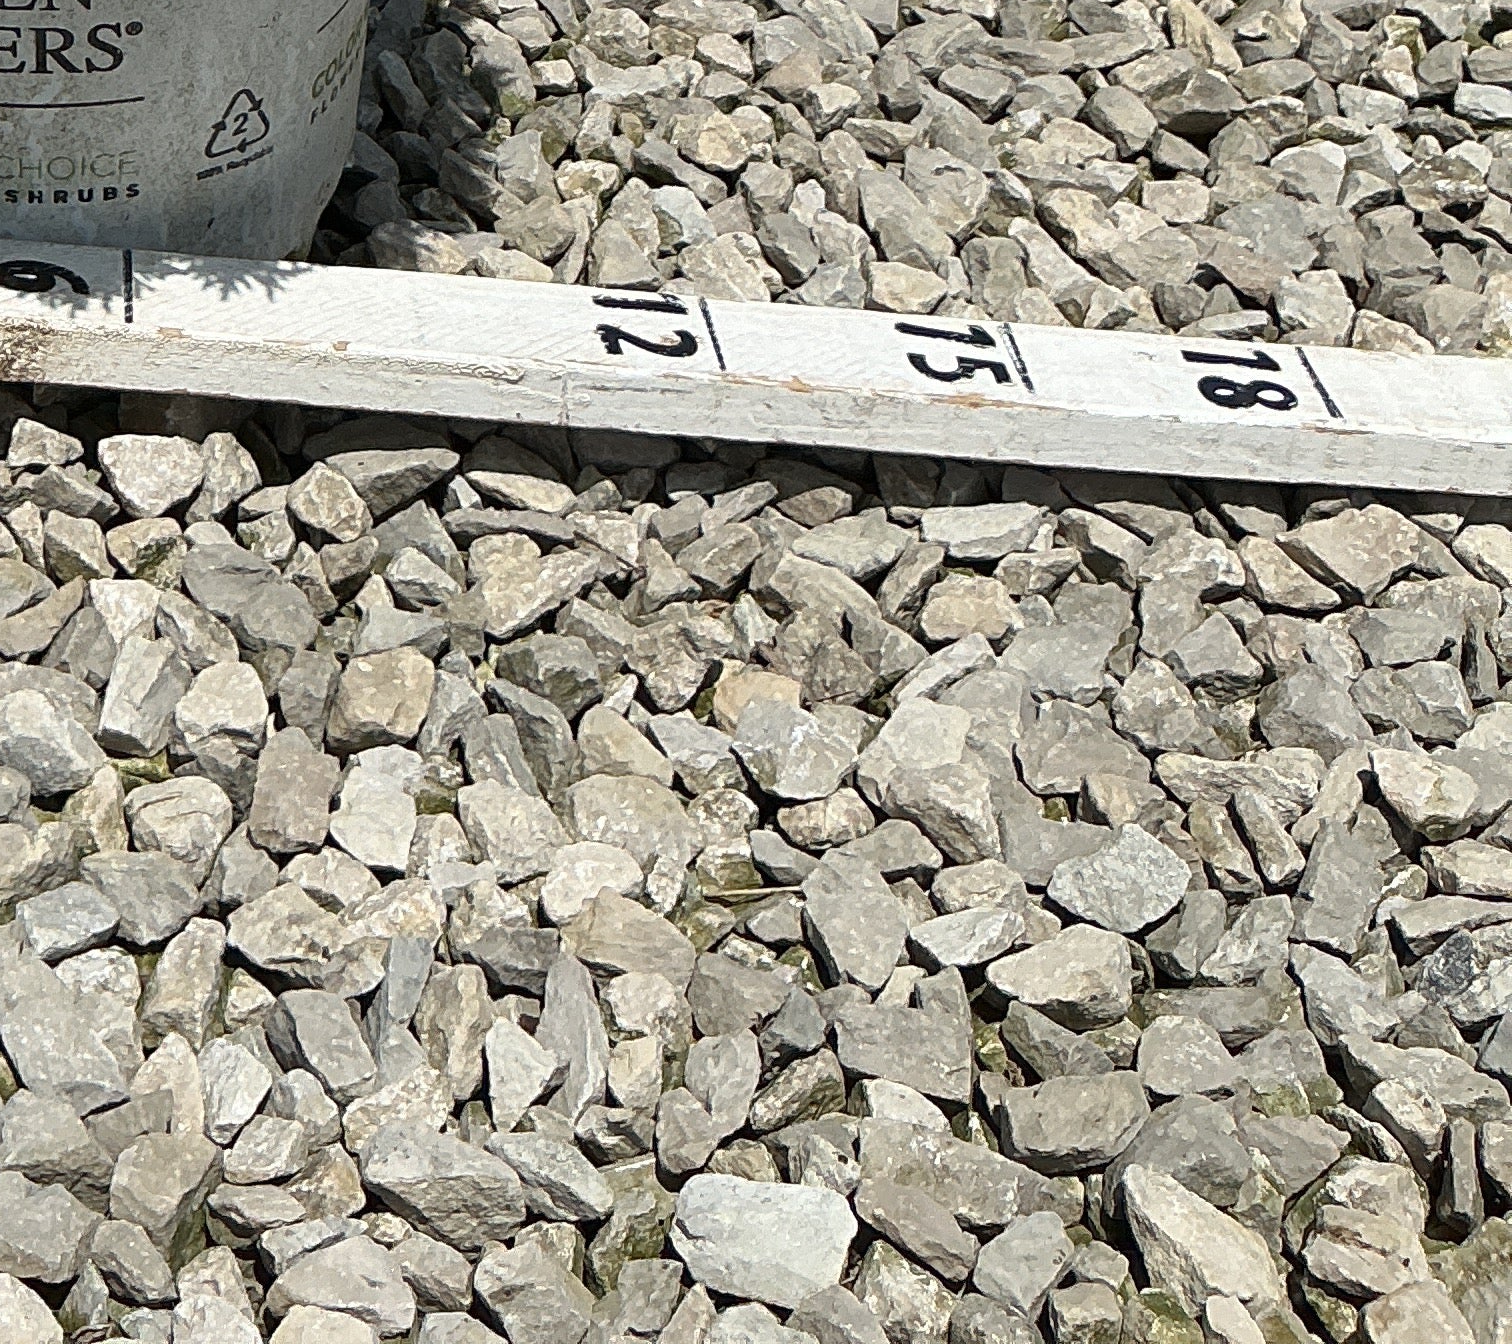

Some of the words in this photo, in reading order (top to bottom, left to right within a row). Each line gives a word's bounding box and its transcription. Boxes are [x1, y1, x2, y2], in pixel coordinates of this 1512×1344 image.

[232, 112, 248, 136] 2
[4, 183, 140, 205] SHRUBS
[592, 293, 699, 359] 12
[894, 320, 1013, 387] 15
[1180, 348, 1300, 413] 18
